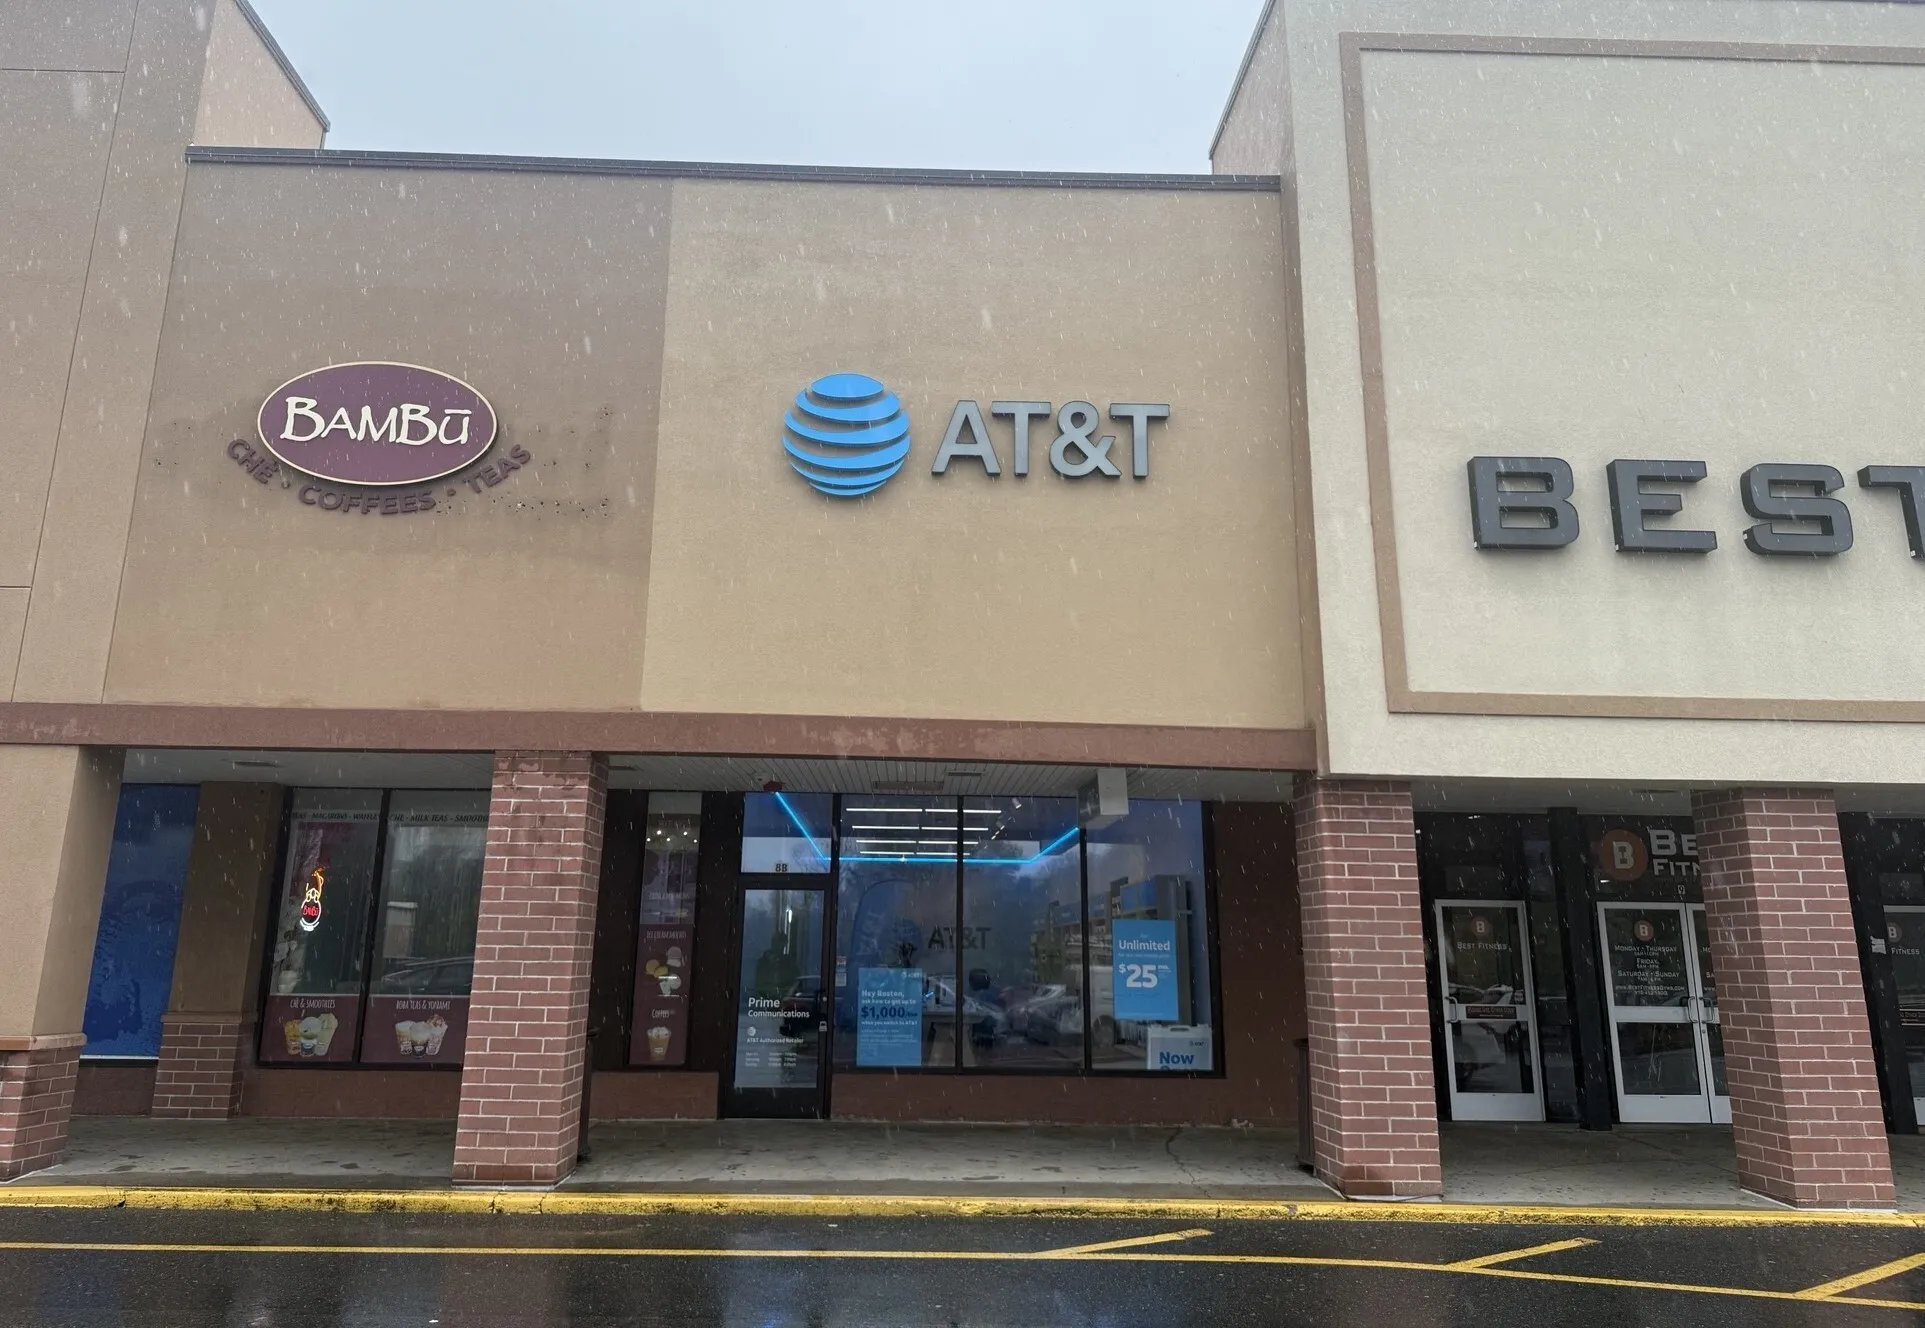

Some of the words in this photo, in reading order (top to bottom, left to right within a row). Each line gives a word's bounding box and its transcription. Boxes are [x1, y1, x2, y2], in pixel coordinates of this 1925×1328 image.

[930, 400, 1171, 478] AT&T
[298, 485, 437, 515] COFFEES
[462, 443, 532, 493] TEAS
[432, 814, 448, 822] TEAS
[1118, 940, 1170, 951] Unlimited
[1457, 942, 1475, 950] BEST
[1118, 962, 1158, 989] $25
[1655, 970, 1680, 978] SUNDAY
[748, 997, 780, 1008] Prime
[748, 1009, 810, 1018] Communications
[861, 1005, 905, 1020] $1,000
[1159, 1051, 1195, 1065] Now
